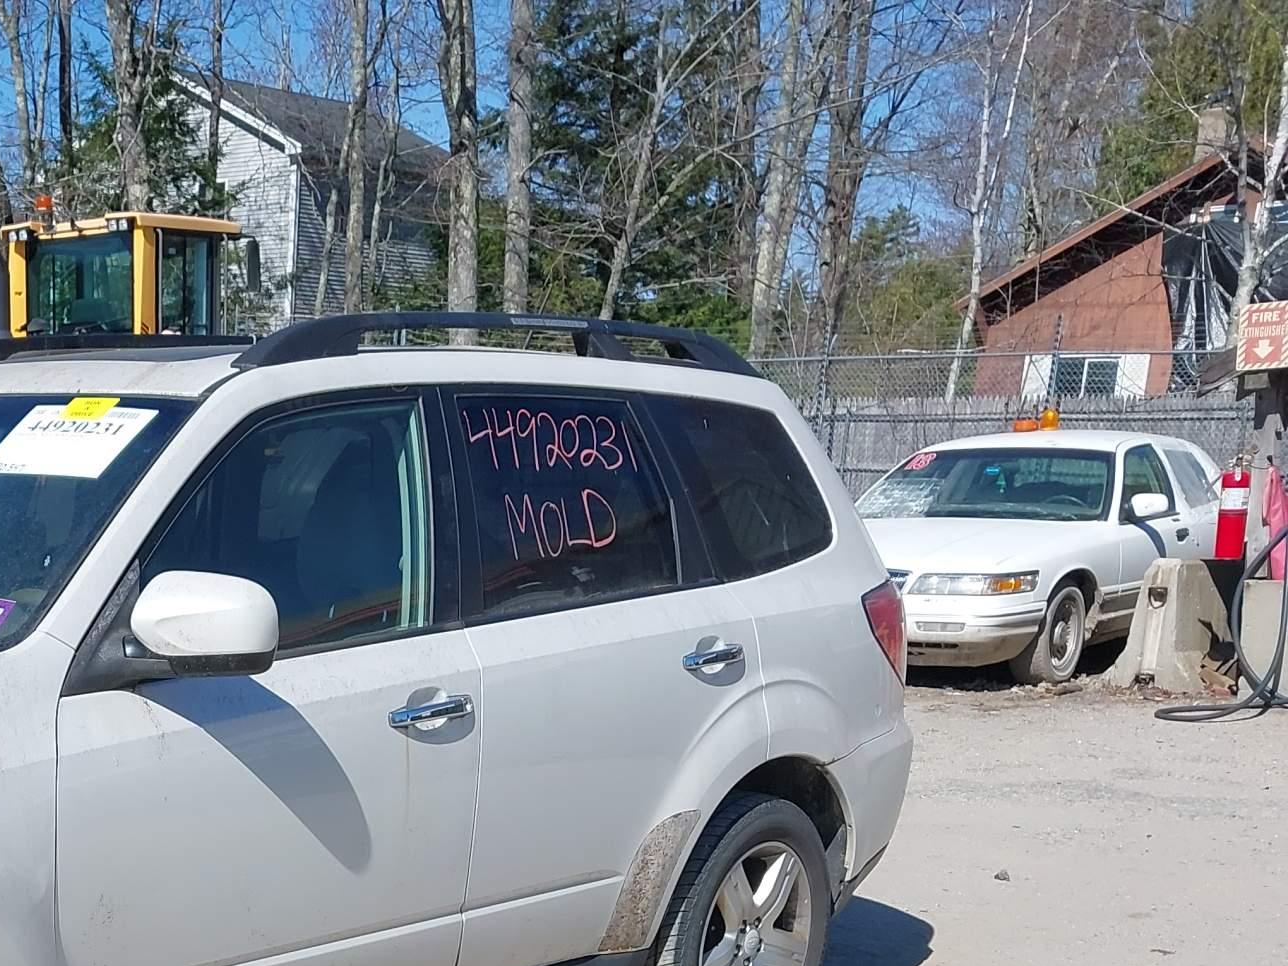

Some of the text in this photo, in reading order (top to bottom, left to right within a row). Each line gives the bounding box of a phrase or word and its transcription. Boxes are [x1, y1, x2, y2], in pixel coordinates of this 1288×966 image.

[1252, 310, 1281, 323] FIRE
[27, 420, 124, 435] 44920231
[462, 407, 638, 473] 44920231
[504, 488, 617, 561] MOLD
